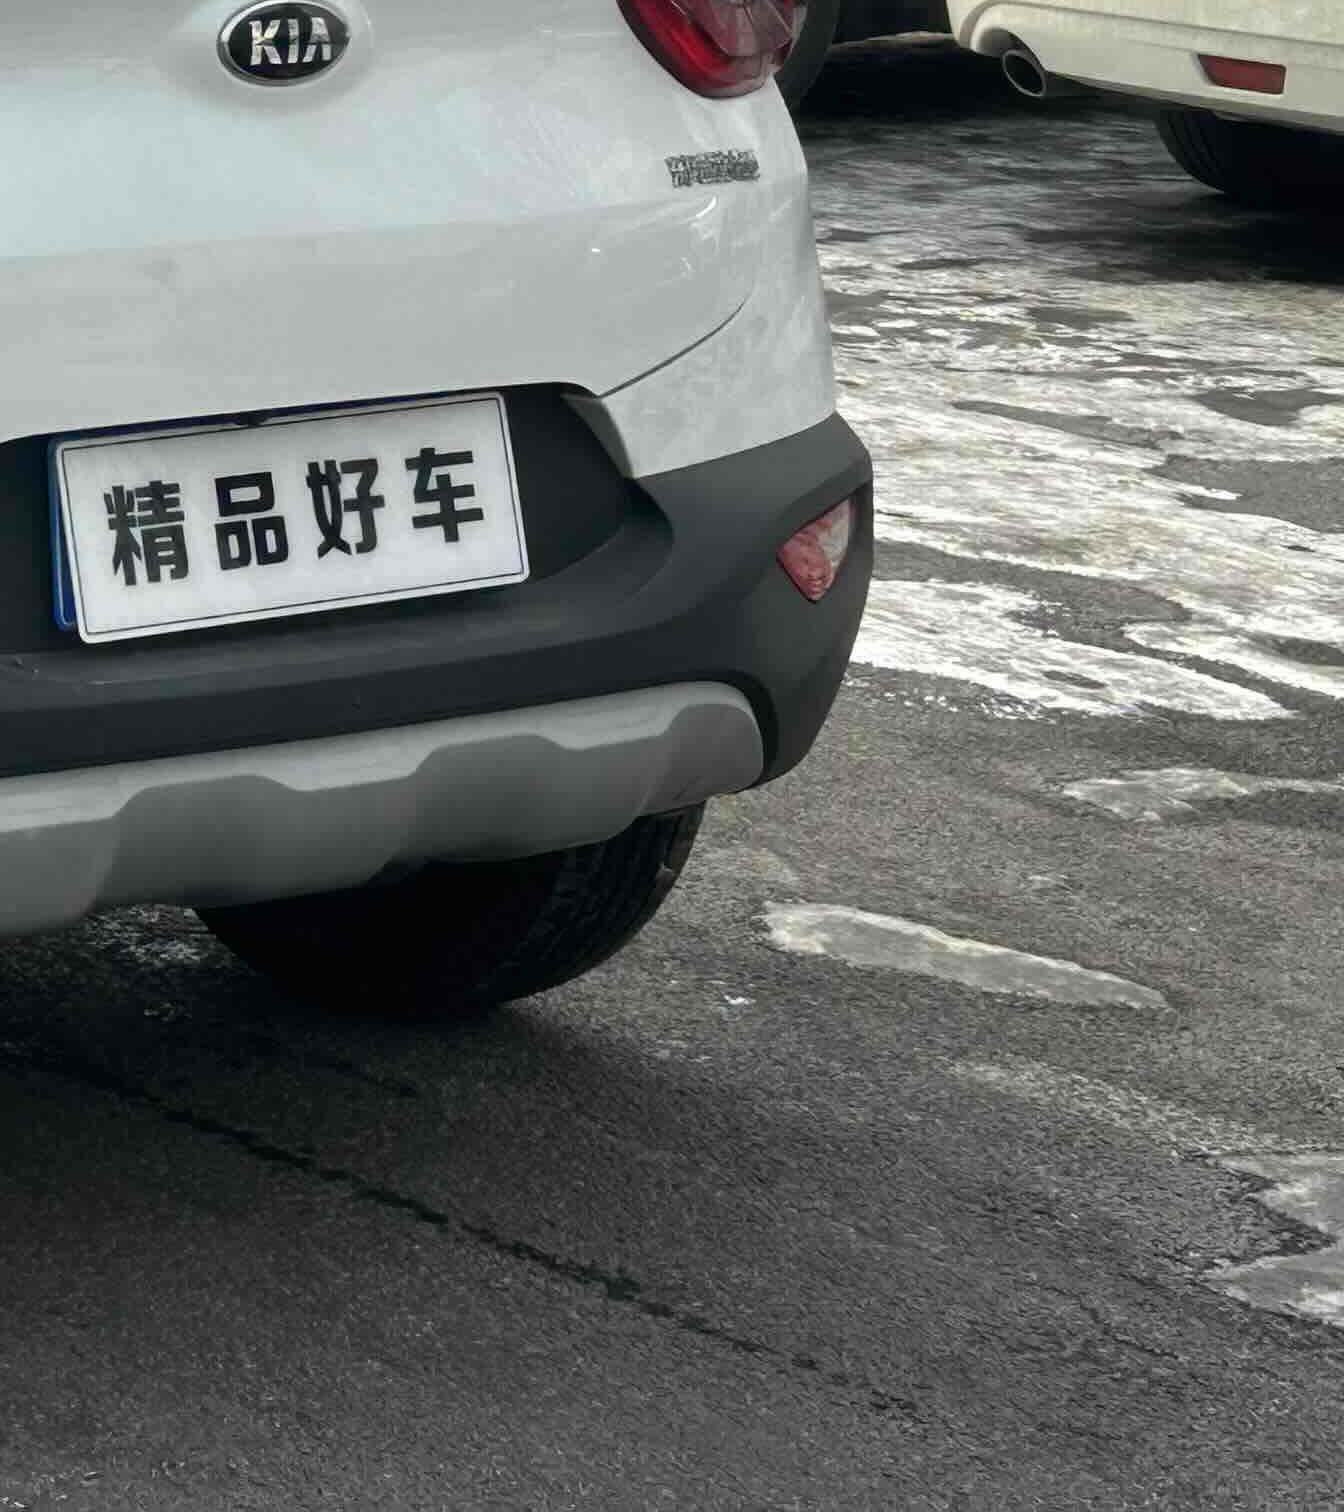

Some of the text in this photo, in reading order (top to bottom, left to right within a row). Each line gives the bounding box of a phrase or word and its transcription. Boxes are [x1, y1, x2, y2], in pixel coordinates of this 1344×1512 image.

[249, 16, 332, 66] KIA
[103, 447, 485, 587] 精品好车
